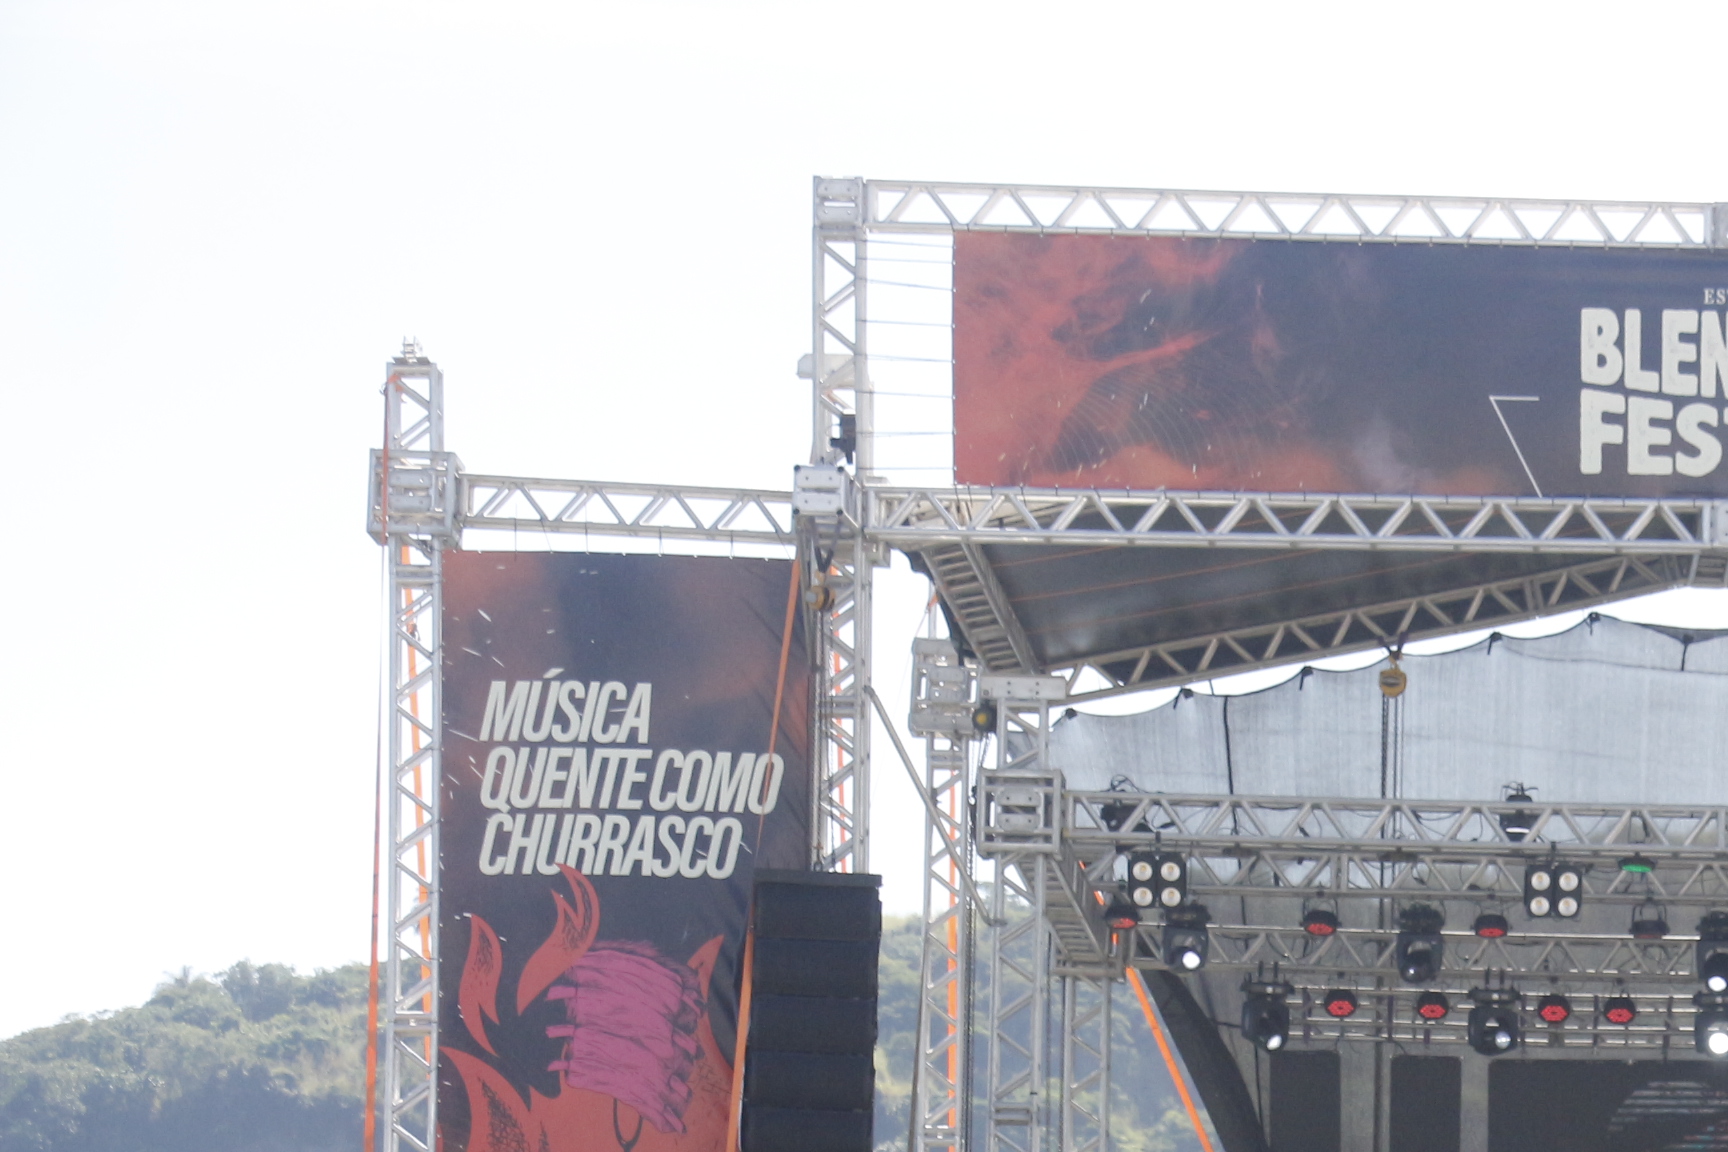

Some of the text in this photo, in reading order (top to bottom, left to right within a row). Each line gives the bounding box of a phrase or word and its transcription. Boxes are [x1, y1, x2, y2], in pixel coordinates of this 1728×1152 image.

[479, 667, 652, 744] MÚSICA
[479, 746, 785, 815] QUENTE COMO
[479, 814, 743, 880] CHURRASCO
